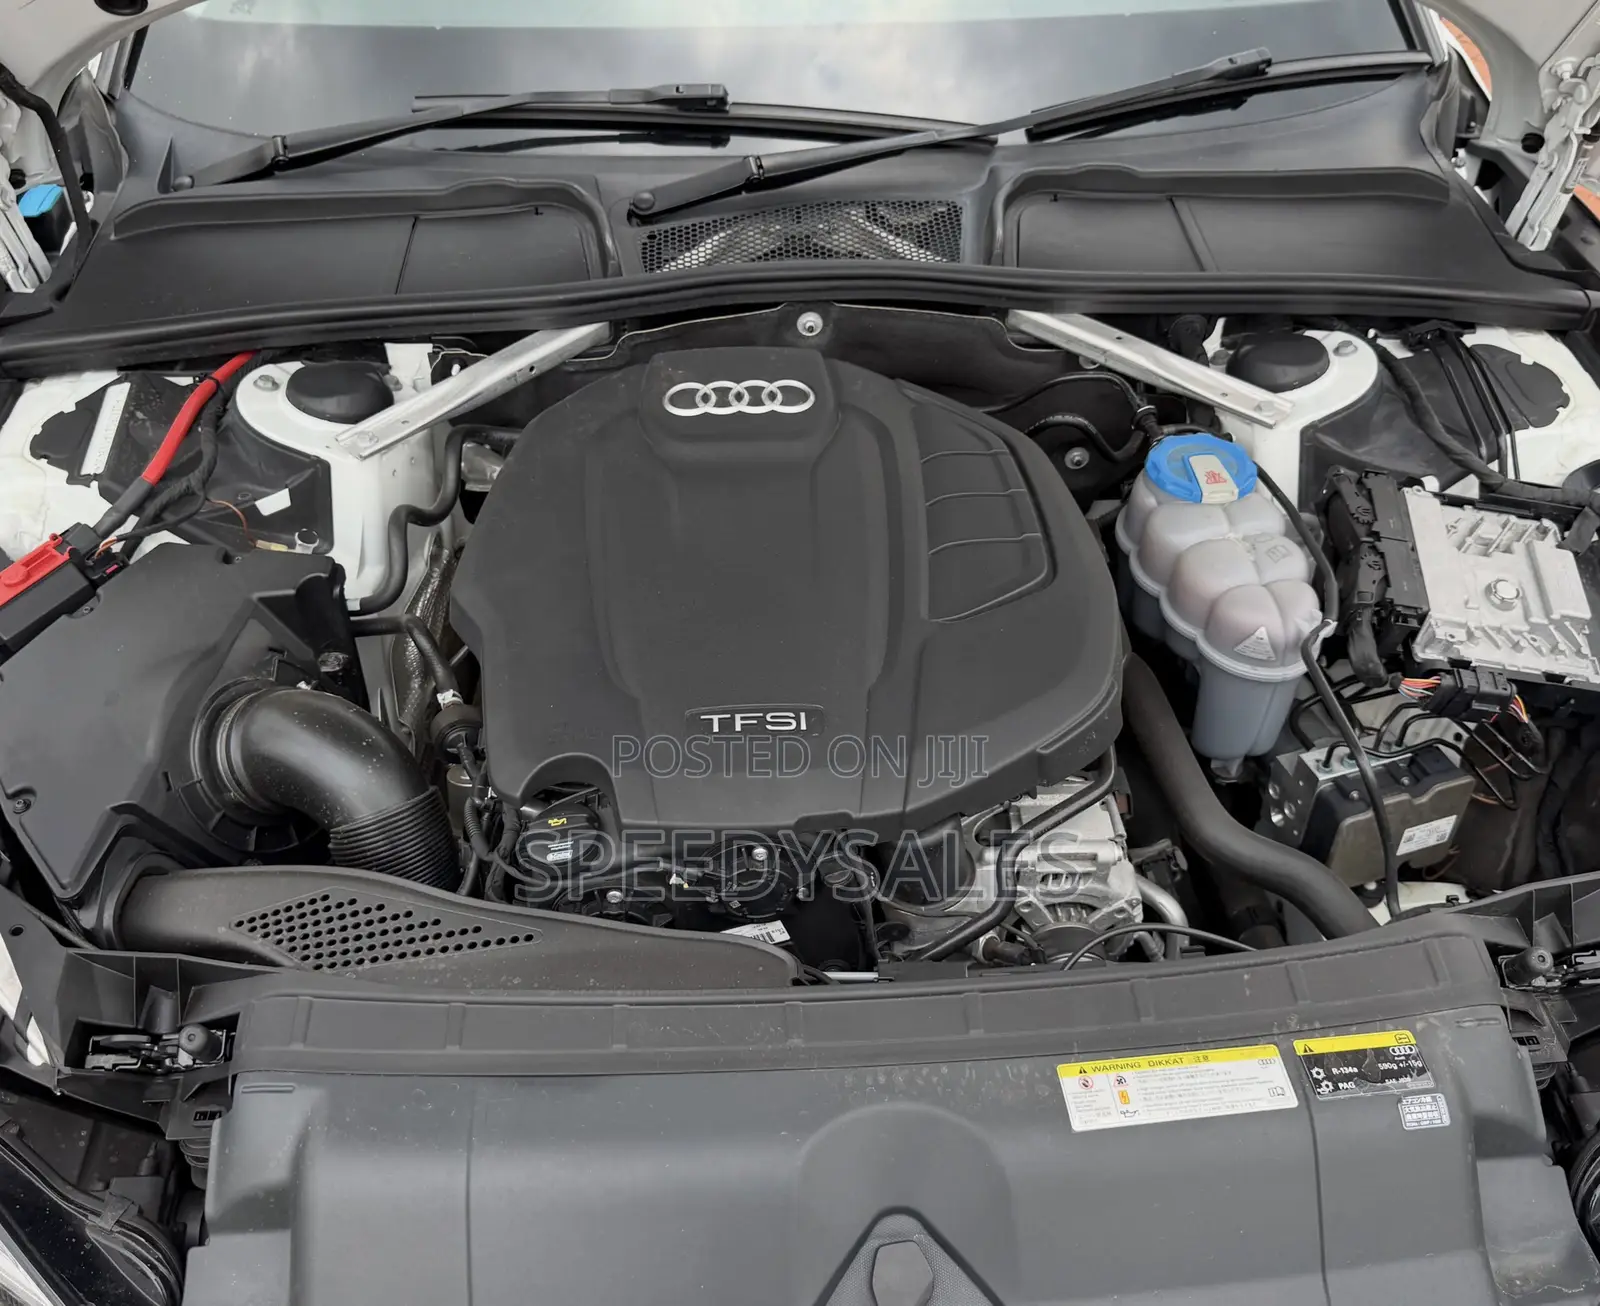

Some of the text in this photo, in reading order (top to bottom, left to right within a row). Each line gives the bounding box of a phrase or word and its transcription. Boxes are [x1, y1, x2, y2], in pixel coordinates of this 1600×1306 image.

[700, 711, 807, 733] TFSI
[1091, 1057, 1184, 1073] WARNING DIKKAT
